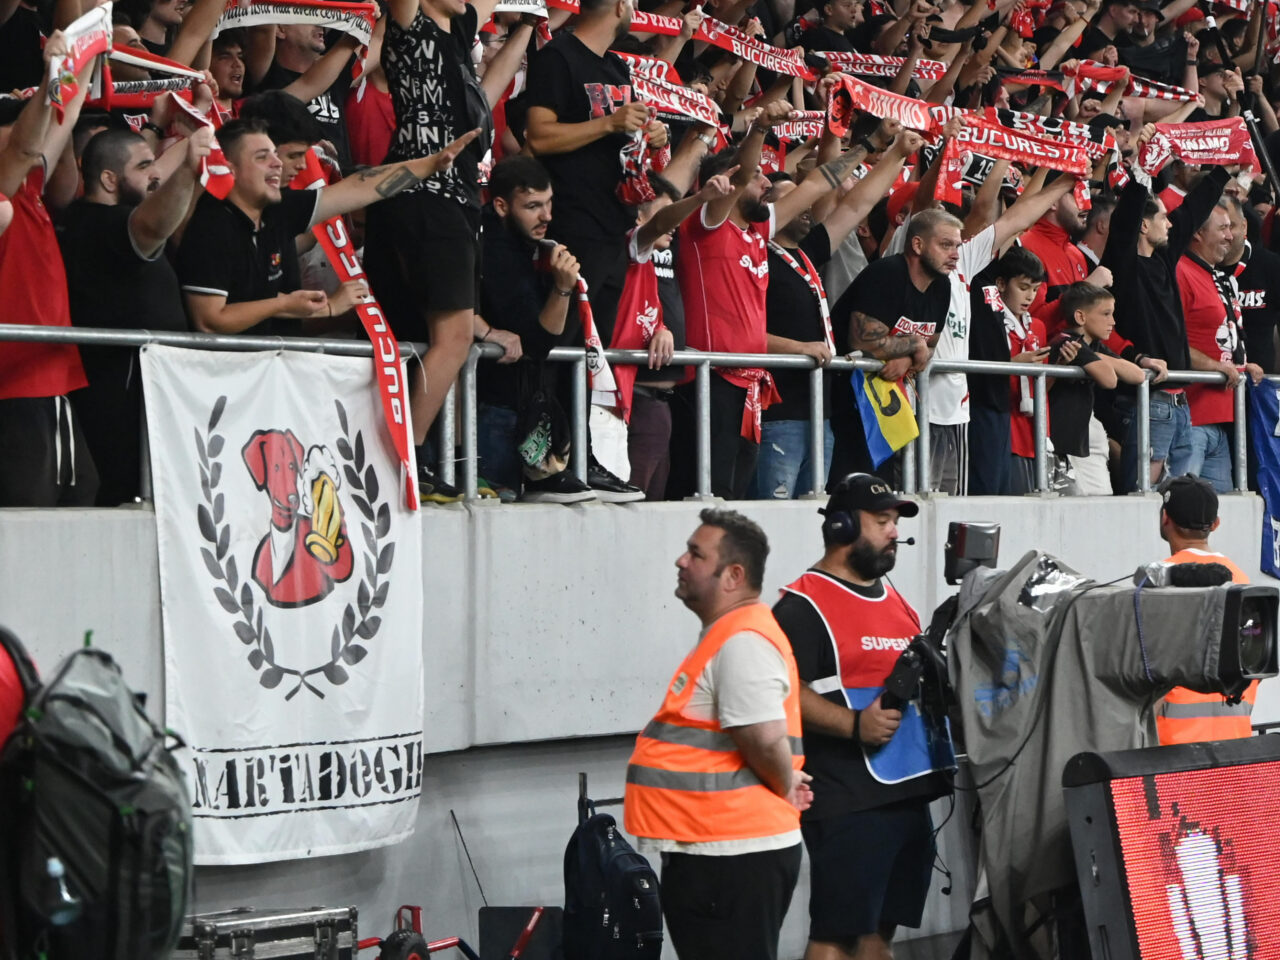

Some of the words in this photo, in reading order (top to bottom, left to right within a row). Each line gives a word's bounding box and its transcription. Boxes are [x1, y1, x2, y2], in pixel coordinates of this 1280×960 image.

[731, 39, 800, 77] BUCURESTI
[868, 91, 925, 130] DINAMO
[957, 125, 1079, 162] BUCURESTI
